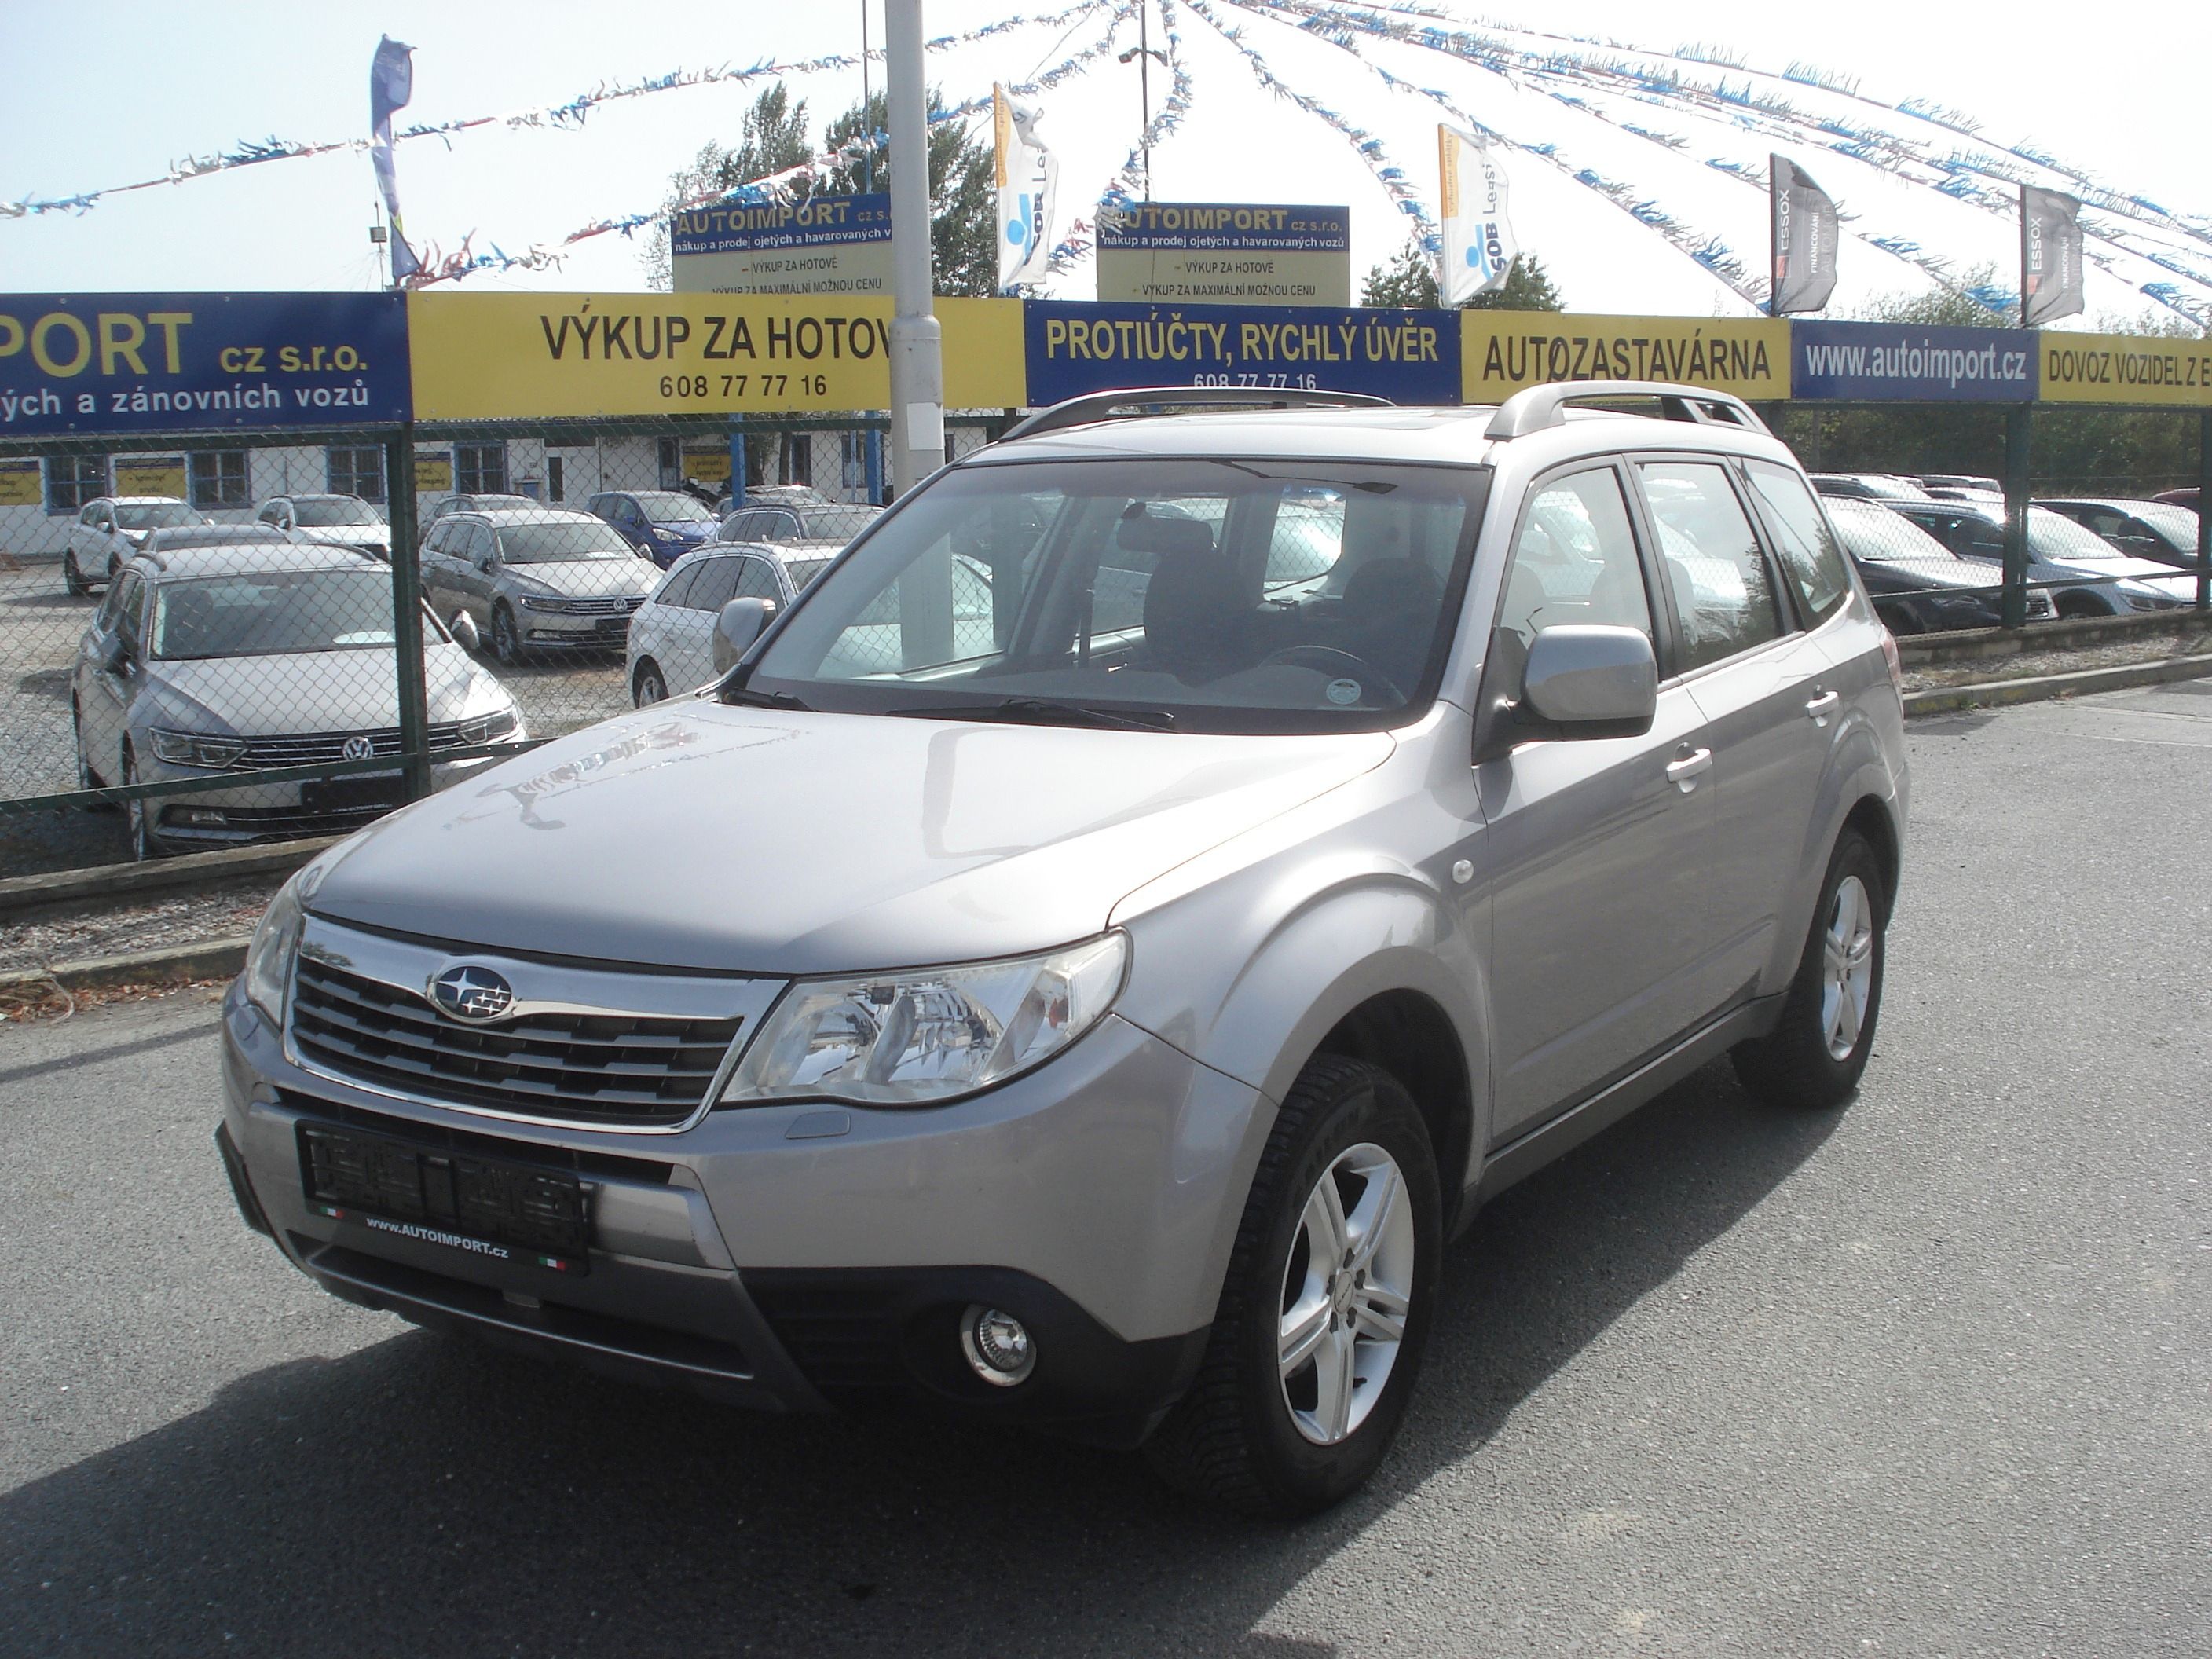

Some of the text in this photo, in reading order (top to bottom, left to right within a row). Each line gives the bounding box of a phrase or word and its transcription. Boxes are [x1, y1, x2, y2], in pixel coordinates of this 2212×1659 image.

[676, 201, 851, 236] AUTOIMPORT
[1122, 207, 1288, 231] UTOIMPORT
[1310, 220, 1342, 233] s.r.o.
[1779, 189, 1790, 251] ESSOX
[676, 238, 707, 254] nákup
[719, 236, 751, 251] prodej
[754, 233, 793, 248] ojetých
[796, 235, 803, 244] a
[805, 228, 881, 244] havarovaných
[1104, 235, 1138, 248] nákup
[1152, 236, 1188, 249] prodej
[1190, 236, 1229, 249] ojetých
[1232, 238, 1240, 247] a
[1242, 236, 1317, 250] havarovaných
[1319, 236, 1345, 248] vozů
[1485, 222, 1507, 273] SOB
[2031, 217, 2042, 270] ESSOX
[786, 260, 797, 272] ZA
[800, 256, 838, 270] HOTOVÉ
[1220, 262, 1232, 273] ZA
[813, 279, 853, 292] MOŽNOU
[856, 277, 881, 290] CENU
[1177, 285, 1191, 296] ZA
[1193, 283, 1246, 296] MAXIMÁLNÍ
[1247, 283, 1288, 296] MOŽNOU
[1291, 285, 1316, 297] CENU
[0, 313, 369, 378] PORT cz s.r.o.
[540, 303, 690, 360] VÝKUP
[704, 317, 756, 360] ZA
[1046, 312, 1438, 367] PROTIÚČTY, RYCHLÝ ÚVĚR
[1482, 328, 1772, 382] AUTOZASTAVÁRNA
[1806, 339, 2027, 389] www.autoimport.cz
[2049, 350, 2111, 383] DOVOZ
[2116, 352, 2183, 386] VOZIDEL
[2187, 357, 2196, 386] Z
[660, 375, 826, 397] 608 77 77 16
[1193, 372, 1317, 390] 608 77 77 16
[1, 379, 369, 422] ých a zánovních vozů
[366, 1217, 509, 1258] www.AUTOIMPORT.cz
